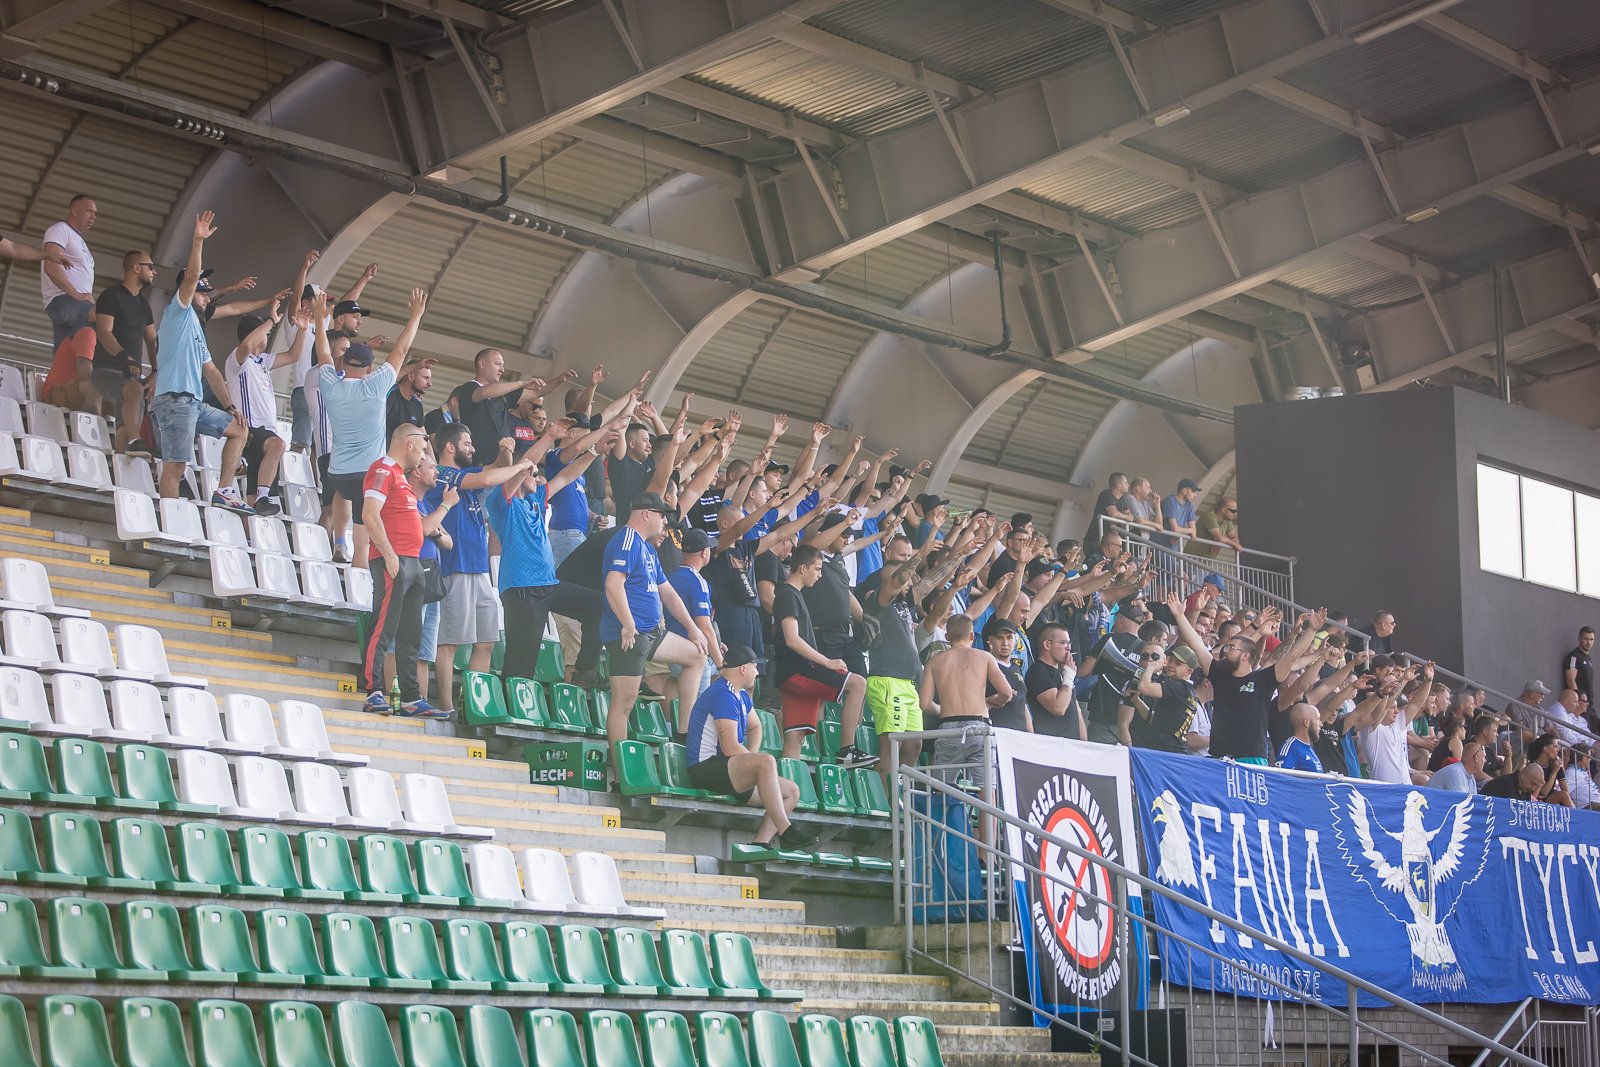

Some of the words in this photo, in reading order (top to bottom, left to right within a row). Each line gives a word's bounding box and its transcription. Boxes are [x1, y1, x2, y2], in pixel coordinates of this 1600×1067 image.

[893, 696, 901, 727] ICON
[532, 768, 567, 782] LECH
[585, 769, 601, 781] LECH
[1226, 766, 1269, 806] KLUB
[1509, 798, 1571, 833] SPORTOWY
[745, 889, 755, 899] E1
[1191, 802, 1350, 957] FANA
[1499, 836, 1600, 964] TYCY
[1532, 971, 1591, 1001] JELENIA
